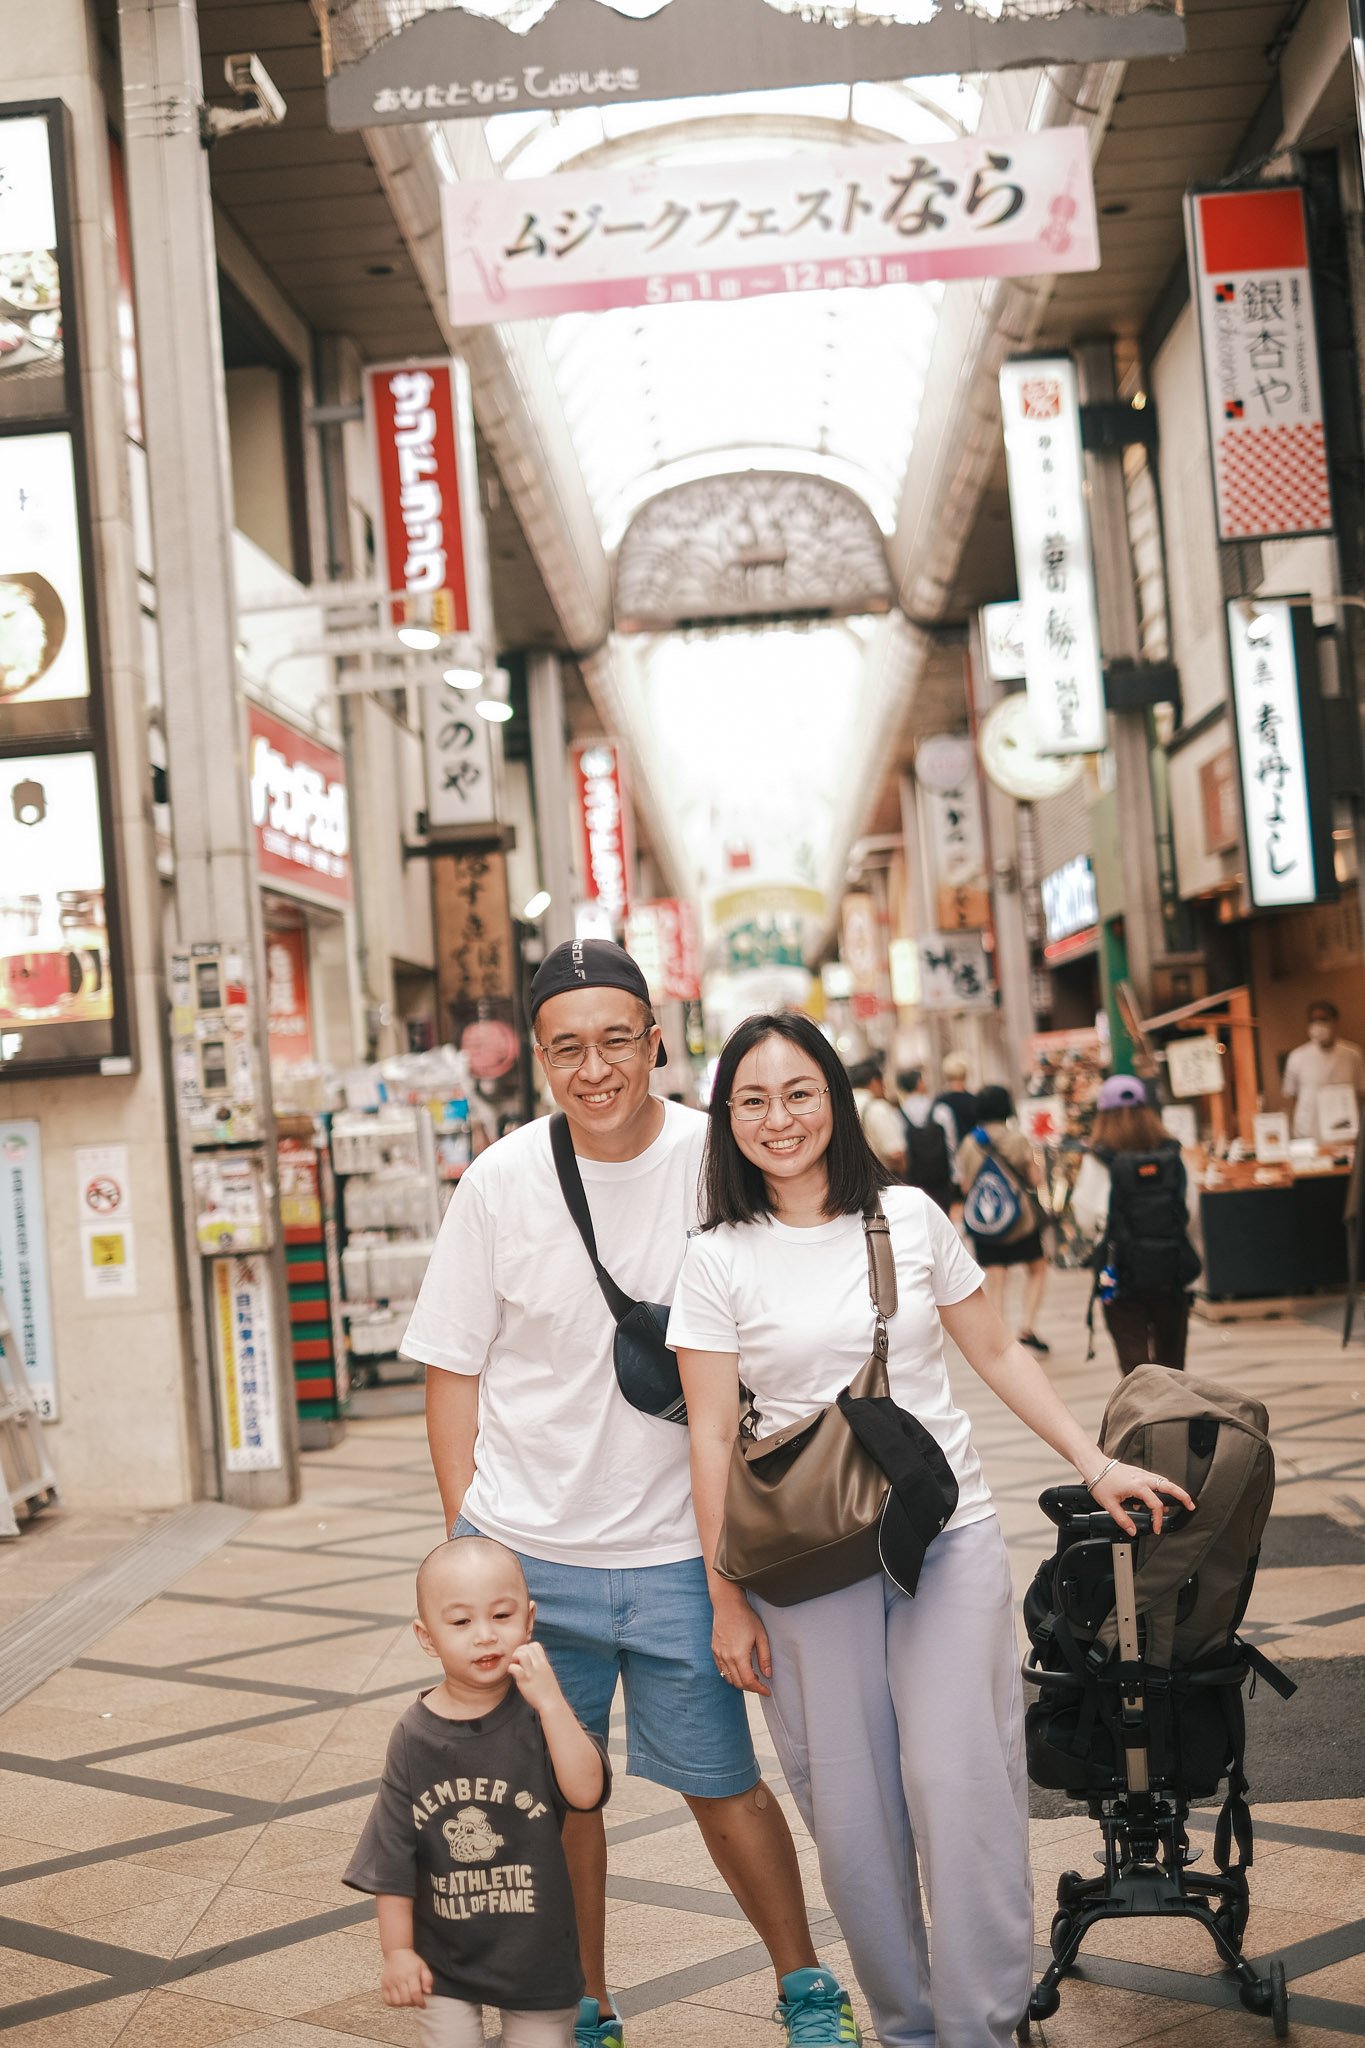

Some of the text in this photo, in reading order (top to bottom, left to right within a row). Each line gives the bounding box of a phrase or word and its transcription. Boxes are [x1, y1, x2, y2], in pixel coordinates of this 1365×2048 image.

[504, 151, 1025, 258] ムジークフェストなら
[1239, 279, 1293, 416] 銀杏や
[388, 371, 447, 593] サンドラッグ
[412, 1777, 508, 1830] MEMBER
[433, 1889, 536, 1920] HALL OF FAME
[448, 1864, 533, 1896] ATHLETIC
